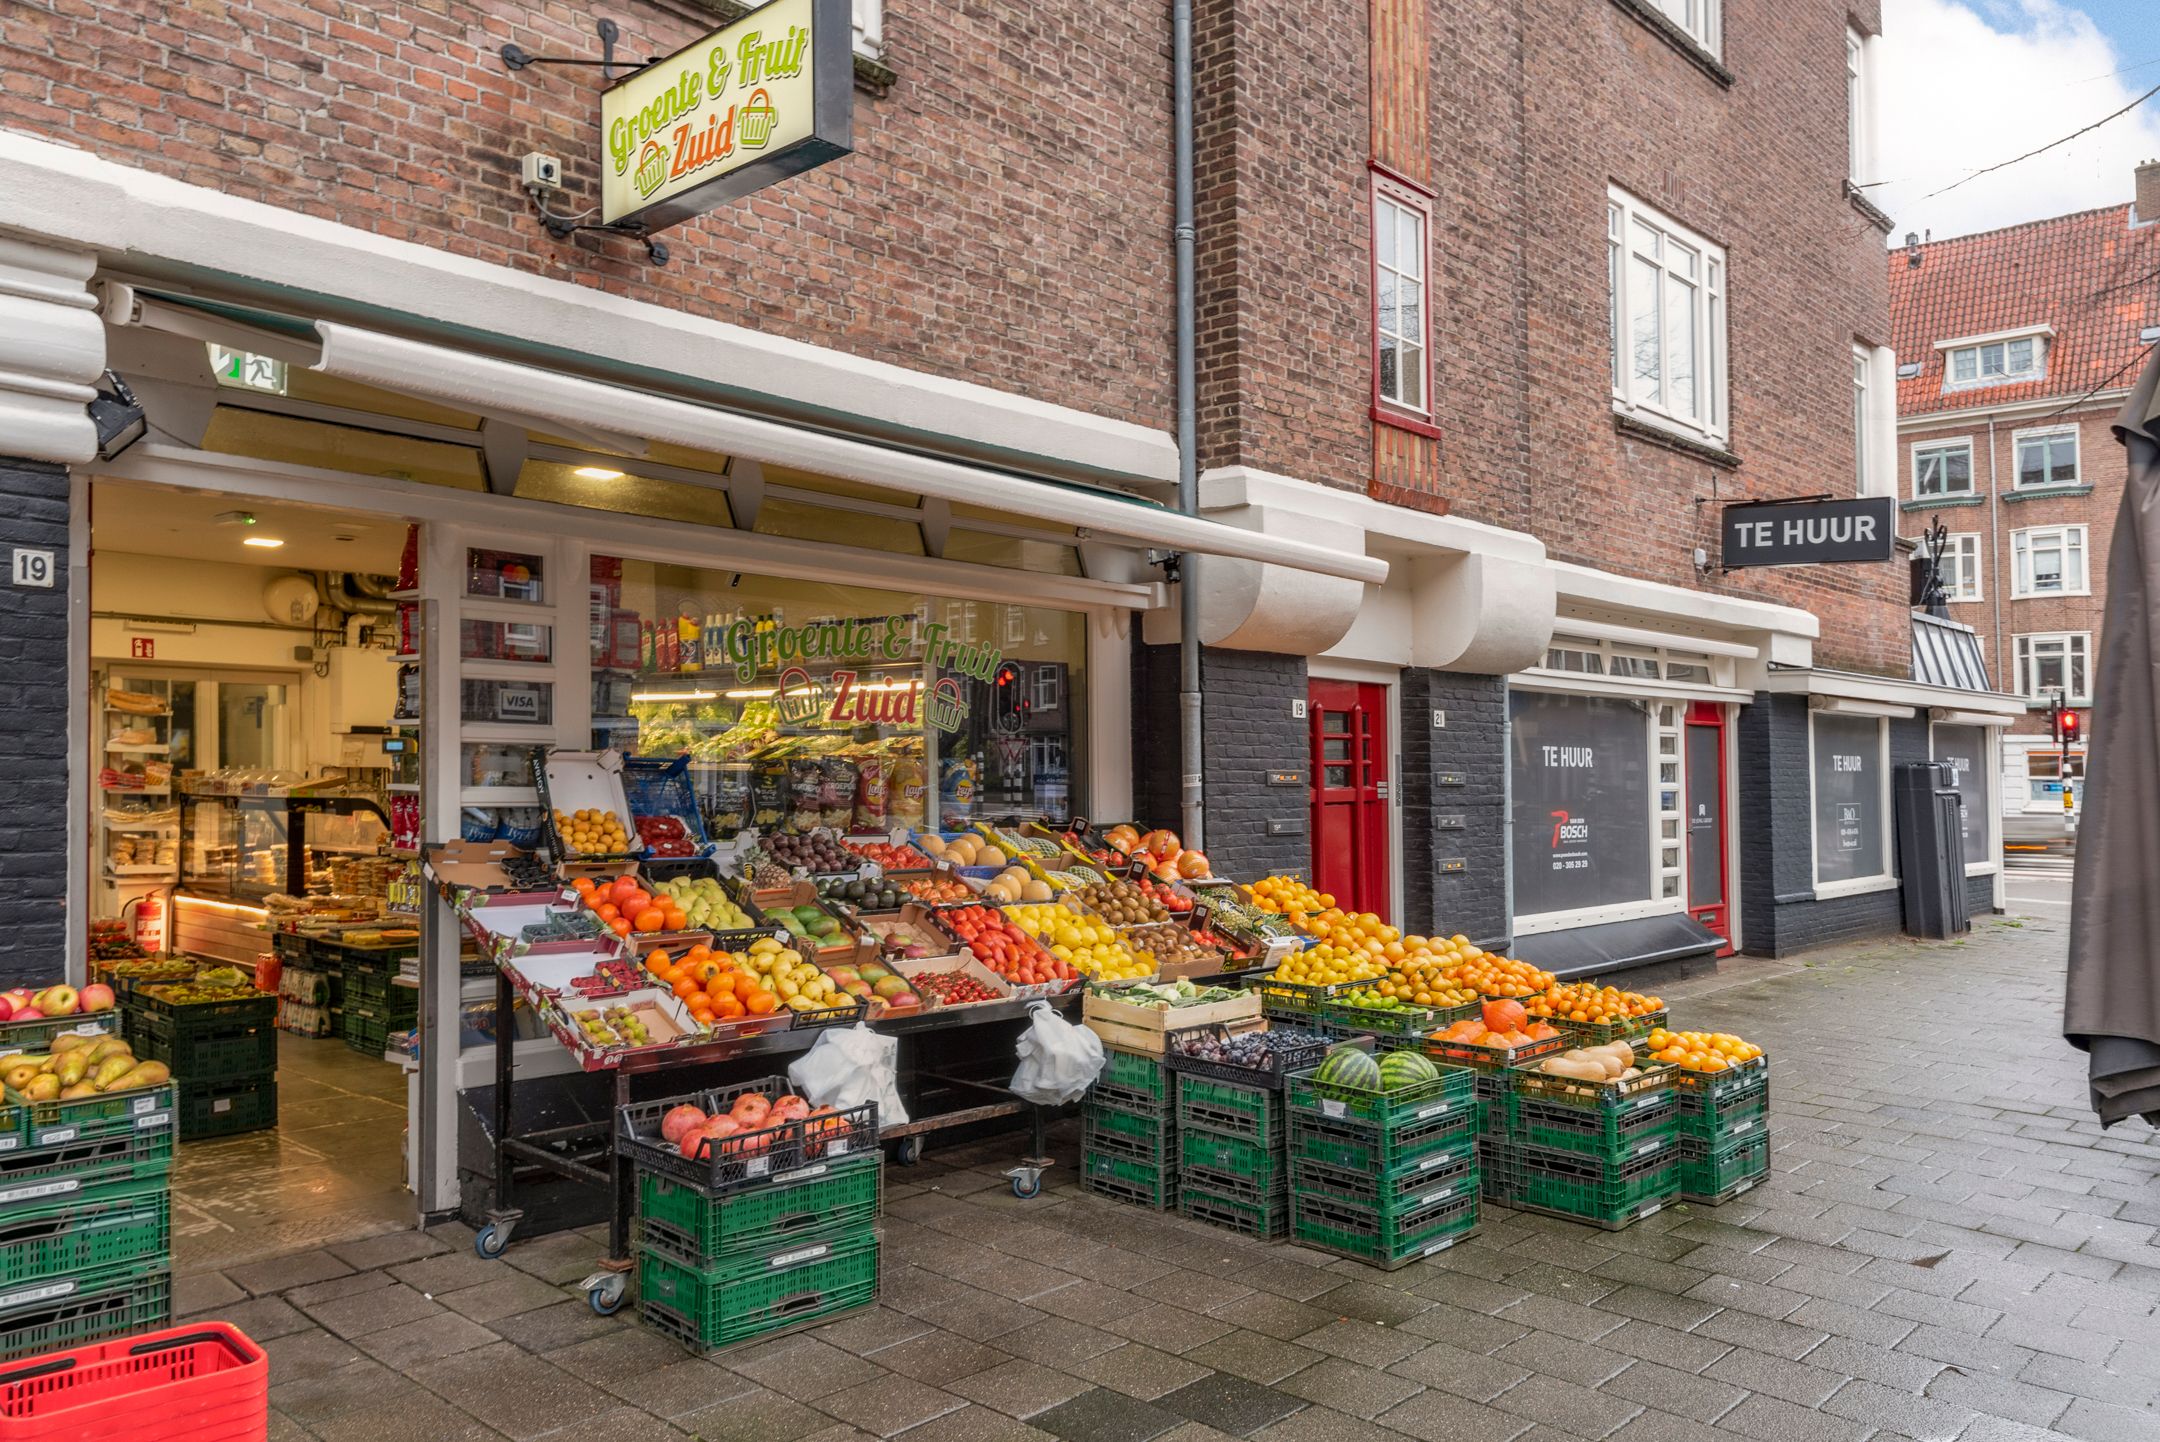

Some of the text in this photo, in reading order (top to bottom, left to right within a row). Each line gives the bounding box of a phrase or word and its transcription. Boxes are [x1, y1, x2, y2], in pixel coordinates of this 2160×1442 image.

[609, 25, 807, 173] Groente & Fruit
[669, 105, 737, 179] Zuid
[1734, 515, 1877, 548] TE HUUR
[20, 554, 46, 581] 19
[727, 614, 1002, 685] Groente & Fruit
[506, 696, 534, 709] VISA
[829, 669, 918, 724] Zuid
[1295, 702, 1304, 716] 19
[1435, 712, 1443, 725] 21
[1542, 746, 1593, 768] TE HUUR
[1833, 755, 1862, 772] TE HUUR
[1560, 825, 1588, 839] BOSCH
